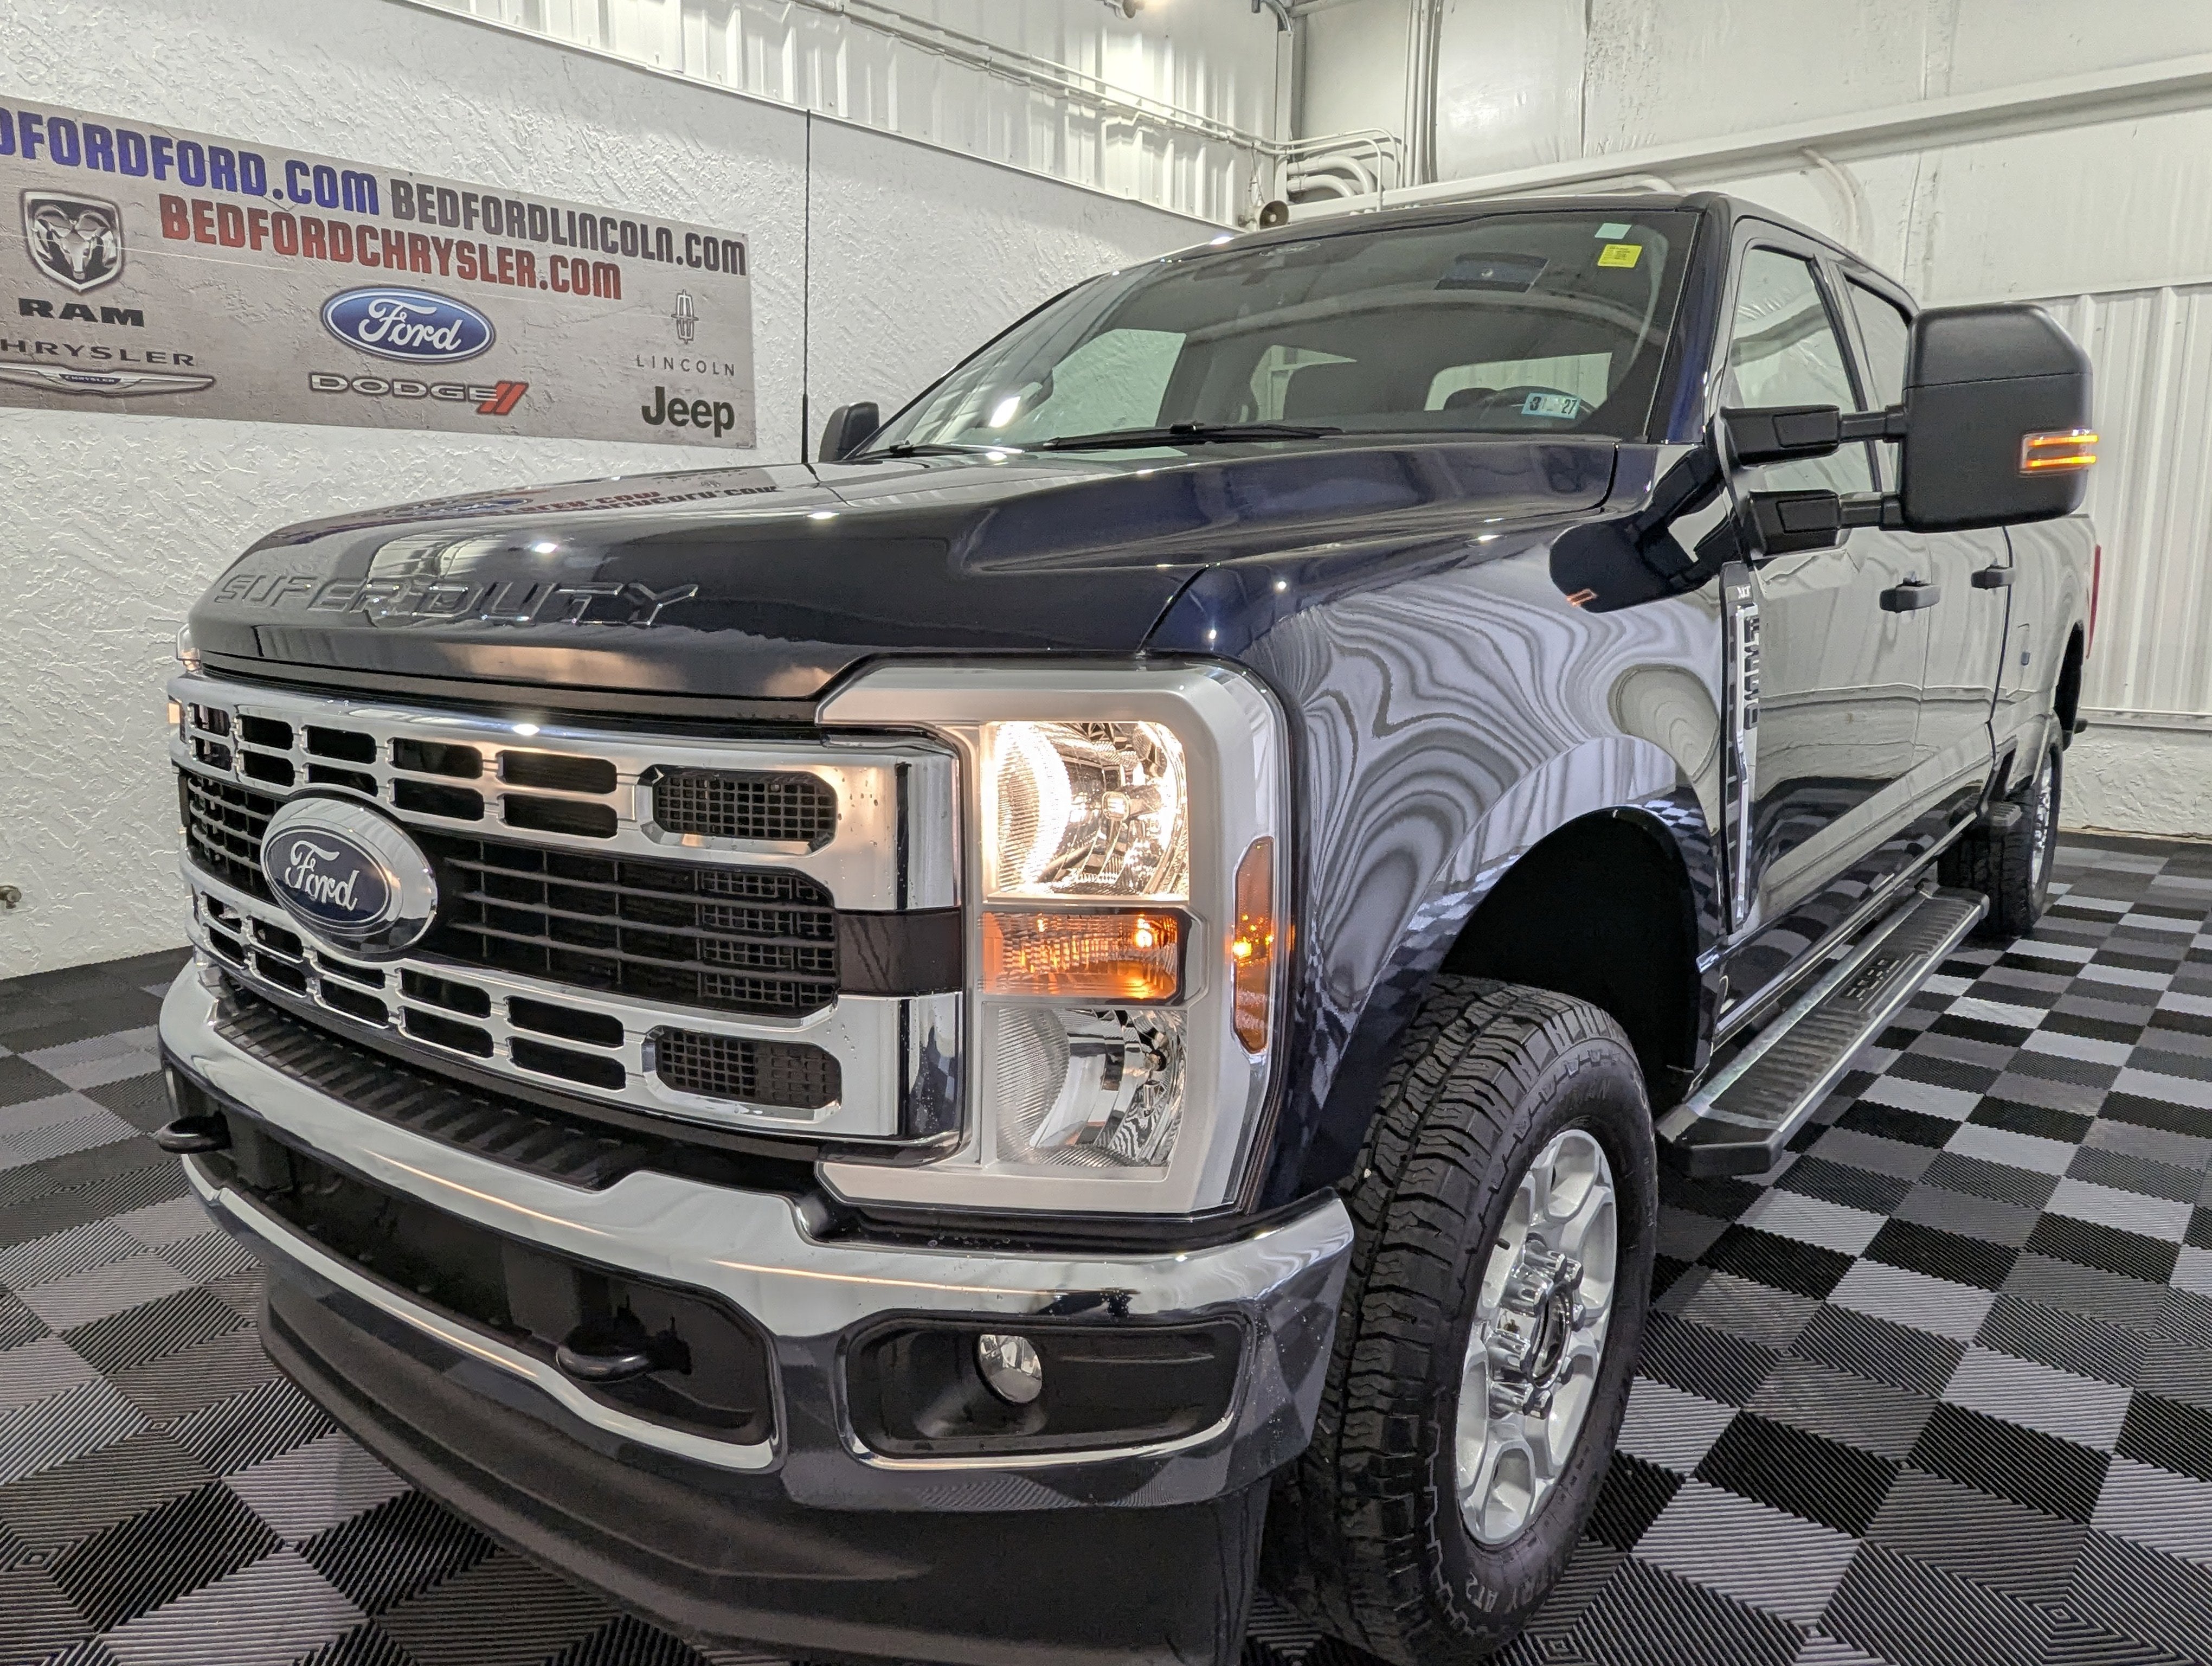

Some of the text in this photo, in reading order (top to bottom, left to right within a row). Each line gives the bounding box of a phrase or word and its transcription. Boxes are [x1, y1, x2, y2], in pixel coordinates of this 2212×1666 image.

[159, 194, 622, 300] BEDFORDCHRYSLER.COM
[390, 178, 746, 275] BEDFORDLINCOLN.COM
[18, 298, 145, 327] RAM
[358, 298, 463, 351] Ford
[310, 374, 498, 402] DODGE
[636, 355, 735, 376] LINCOLN
[641, 386, 735, 438] Jeep
[1561, 399, 1578, 415] 27
[214, 574, 699, 625] SUPER DUTY
[285, 840, 361, 912] Ford
